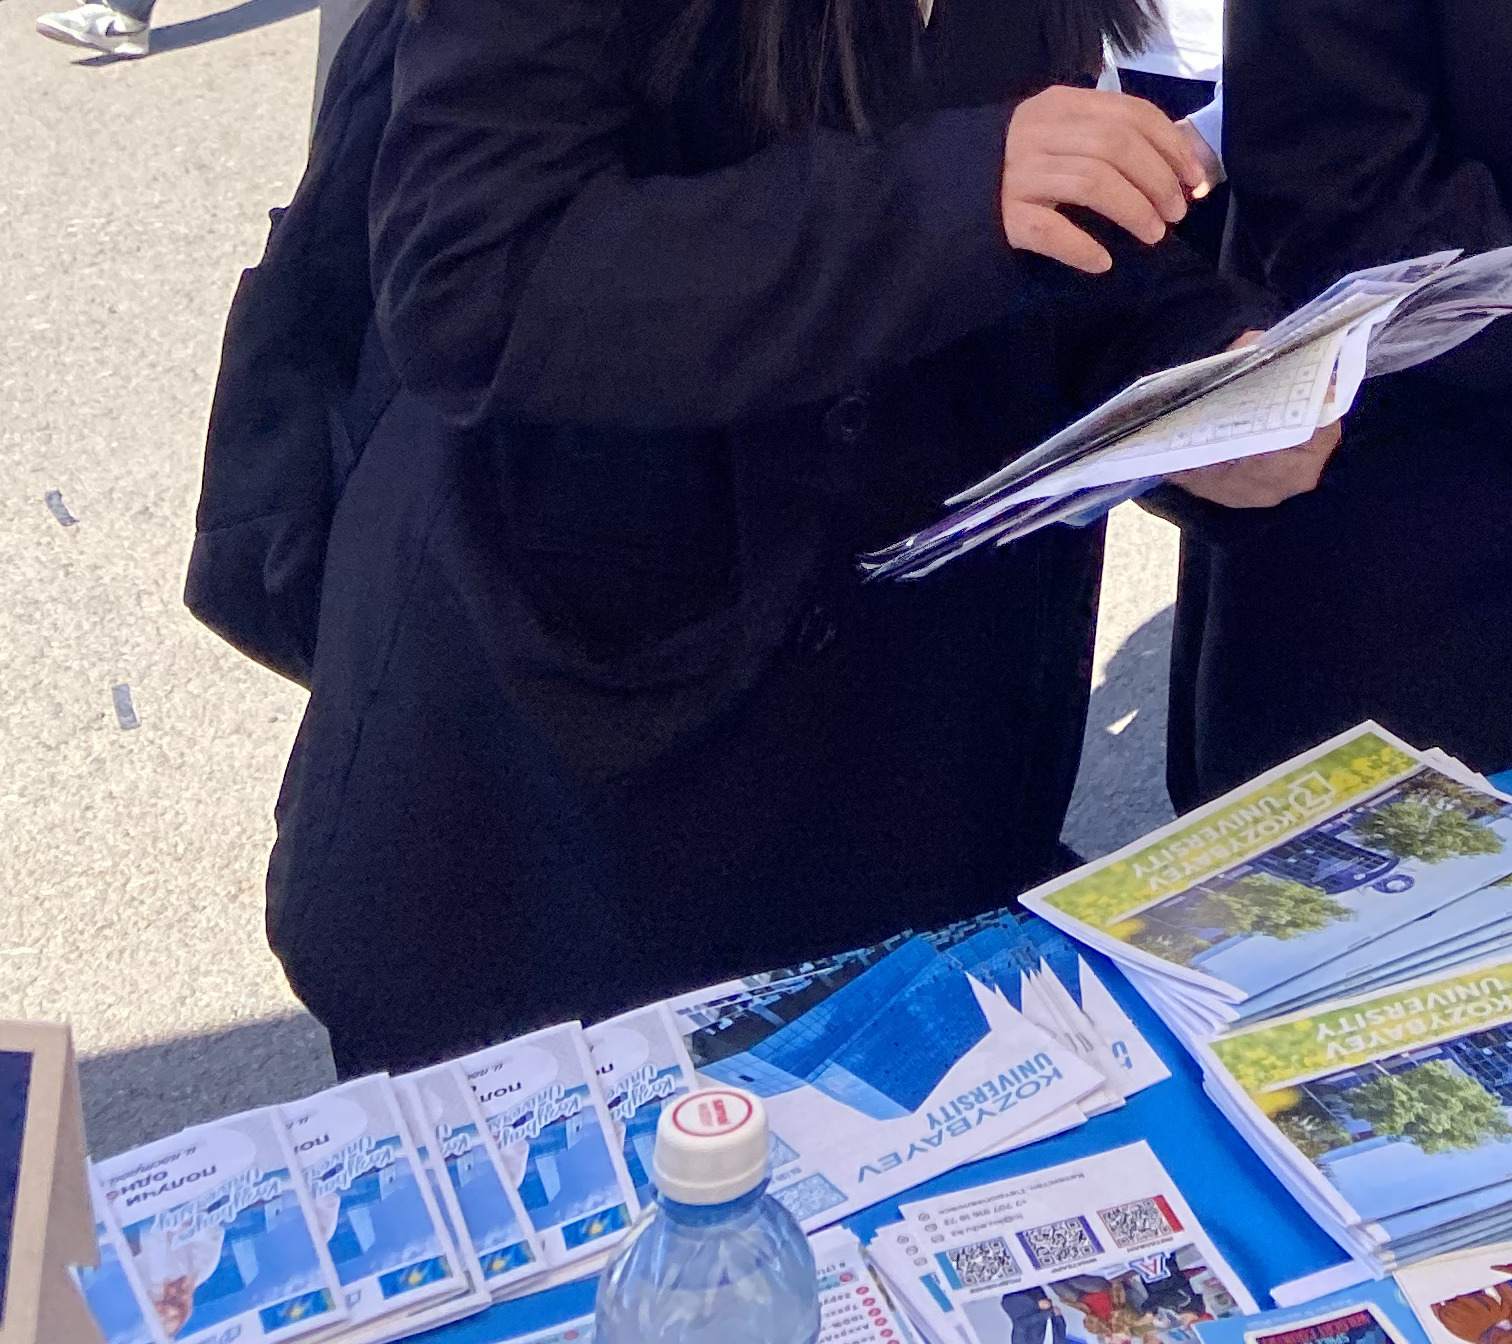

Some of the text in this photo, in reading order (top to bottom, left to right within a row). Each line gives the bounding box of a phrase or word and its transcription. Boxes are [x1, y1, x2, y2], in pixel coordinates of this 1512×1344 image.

[1133, 796, 1280, 879] UNIVERSITY
[1148, 810, 1296, 891] KOZYBAYEV
[1317, 975, 1504, 1040] UNIVERSITY
[858, 1066, 1063, 1183] KOZYBAYEV
[928, 1050, 1053, 1129] UNIVERSITY
